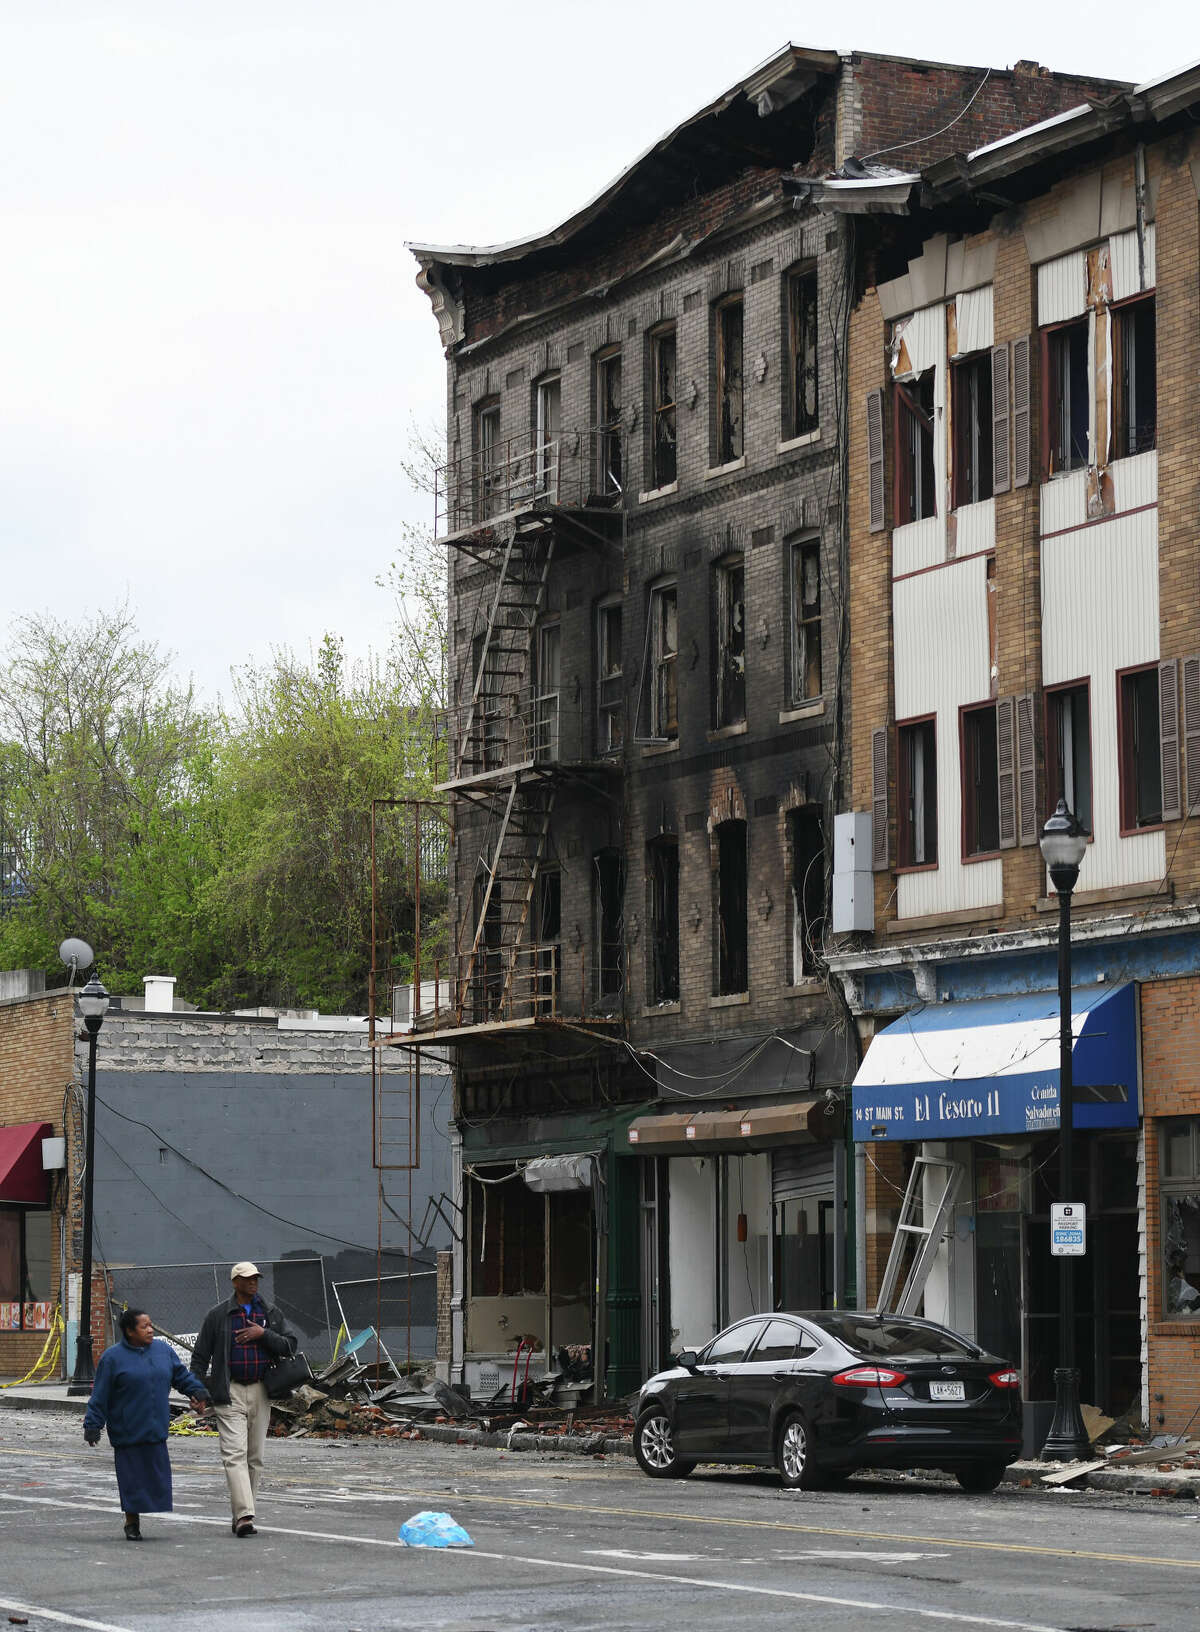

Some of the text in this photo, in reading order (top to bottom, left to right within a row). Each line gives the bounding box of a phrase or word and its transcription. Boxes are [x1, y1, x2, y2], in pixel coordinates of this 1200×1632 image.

[865, 1107, 873, 1120] ST
[876, 1107, 892, 1120] MAIN
[894, 1106, 905, 1120] ST.
[915, 1094, 930, 1121] El
